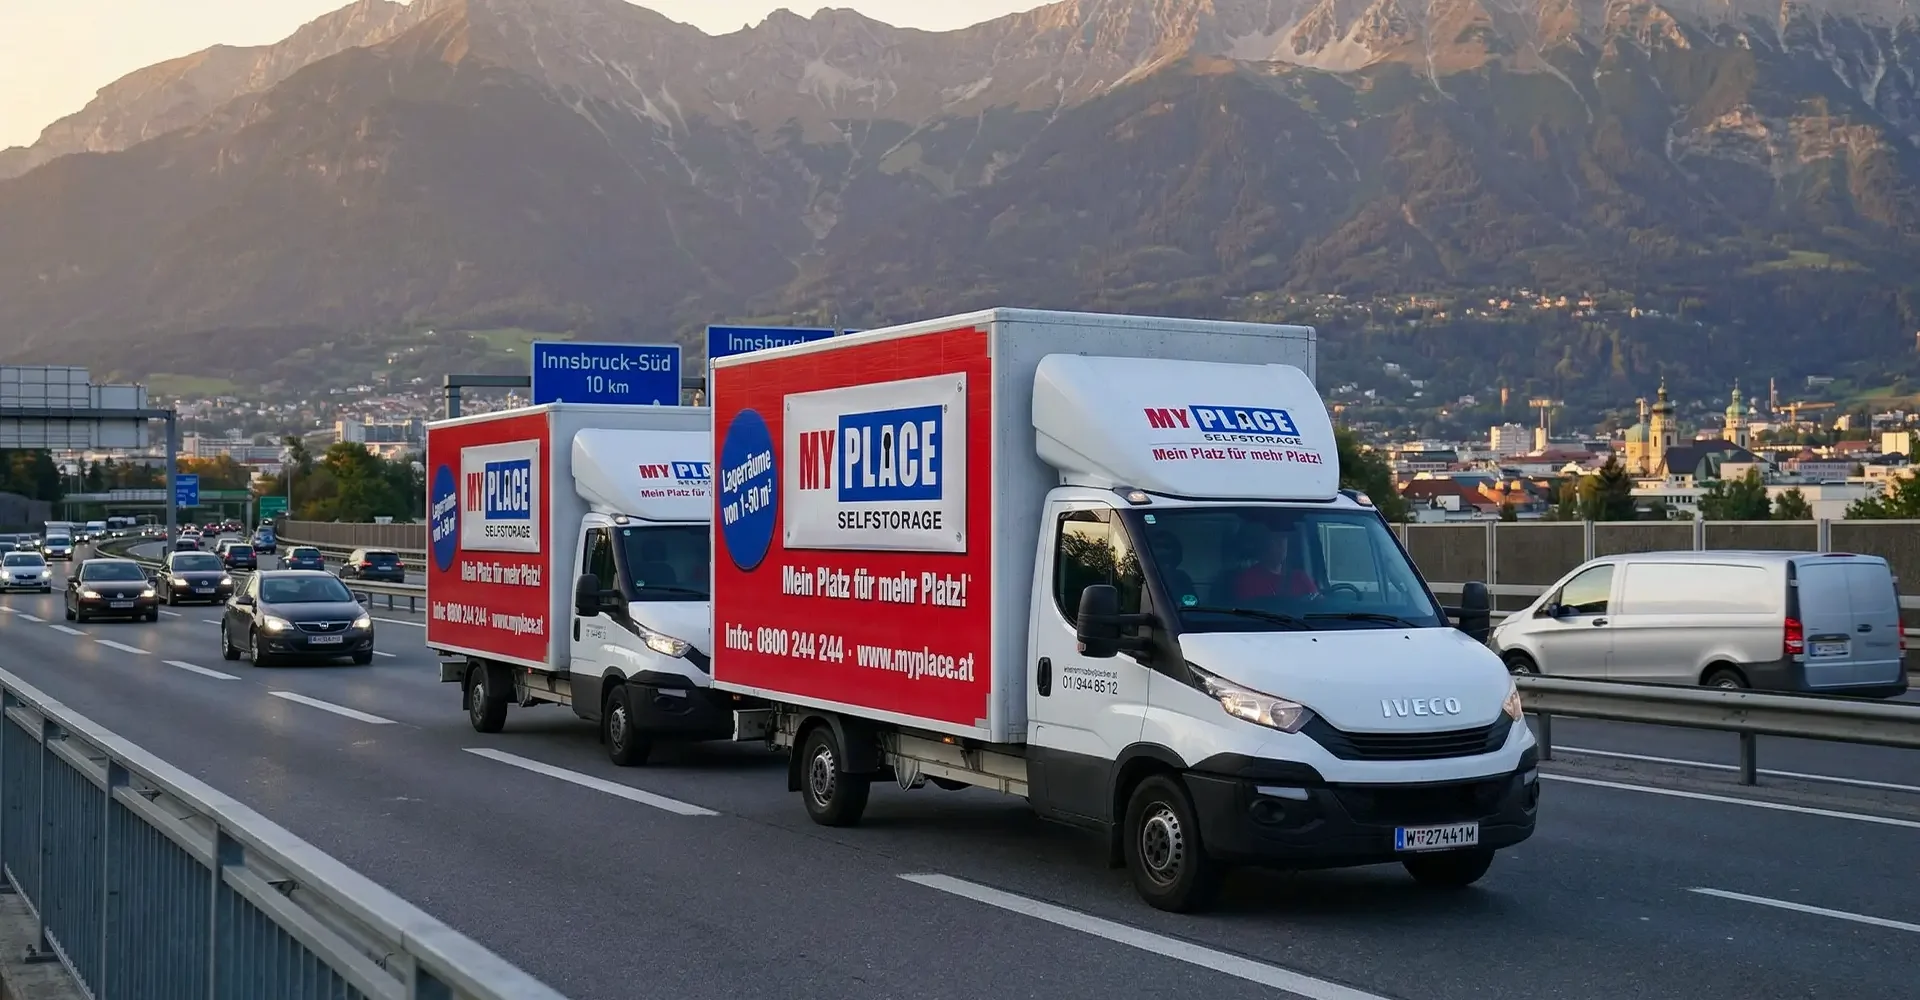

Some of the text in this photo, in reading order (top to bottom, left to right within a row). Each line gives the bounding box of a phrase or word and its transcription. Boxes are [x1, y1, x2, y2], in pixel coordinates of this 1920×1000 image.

[542, 351, 671, 372] Innsbruck-Süd
[586, 375, 629, 394] 10 km
[1144, 408, 1293, 433] MY PLACE
[1203, 433, 1303, 446] SELFSTORAGE
[799, 420, 937, 490] MY PLACE
[1152, 447, 1323, 465] Mein Platz für mehr Platz!
[638, 464, 669, 479] MY
[722, 450, 771, 494] Lagerräume
[467, 467, 529, 512] MY PLACE
[641, 489, 665, 498] Mein
[666, 488, 690, 497] Platz
[692, 488, 705, 497] für
[723, 501, 739, 526] von
[740, 486, 759, 517] 1-50
[837, 510, 942, 530] SELFSTORAGE
[485, 525, 531, 539] SELFSTORAGE
[782, 565, 967, 607] Mein Platz für mehr Platz!
[462, 604, 474, 625] 244
[474, 606, 487, 627] 244
[725, 622, 975, 682] Info: 0800 244 244 www.myplace.at
[1380, 697, 1462, 718] IVECO
